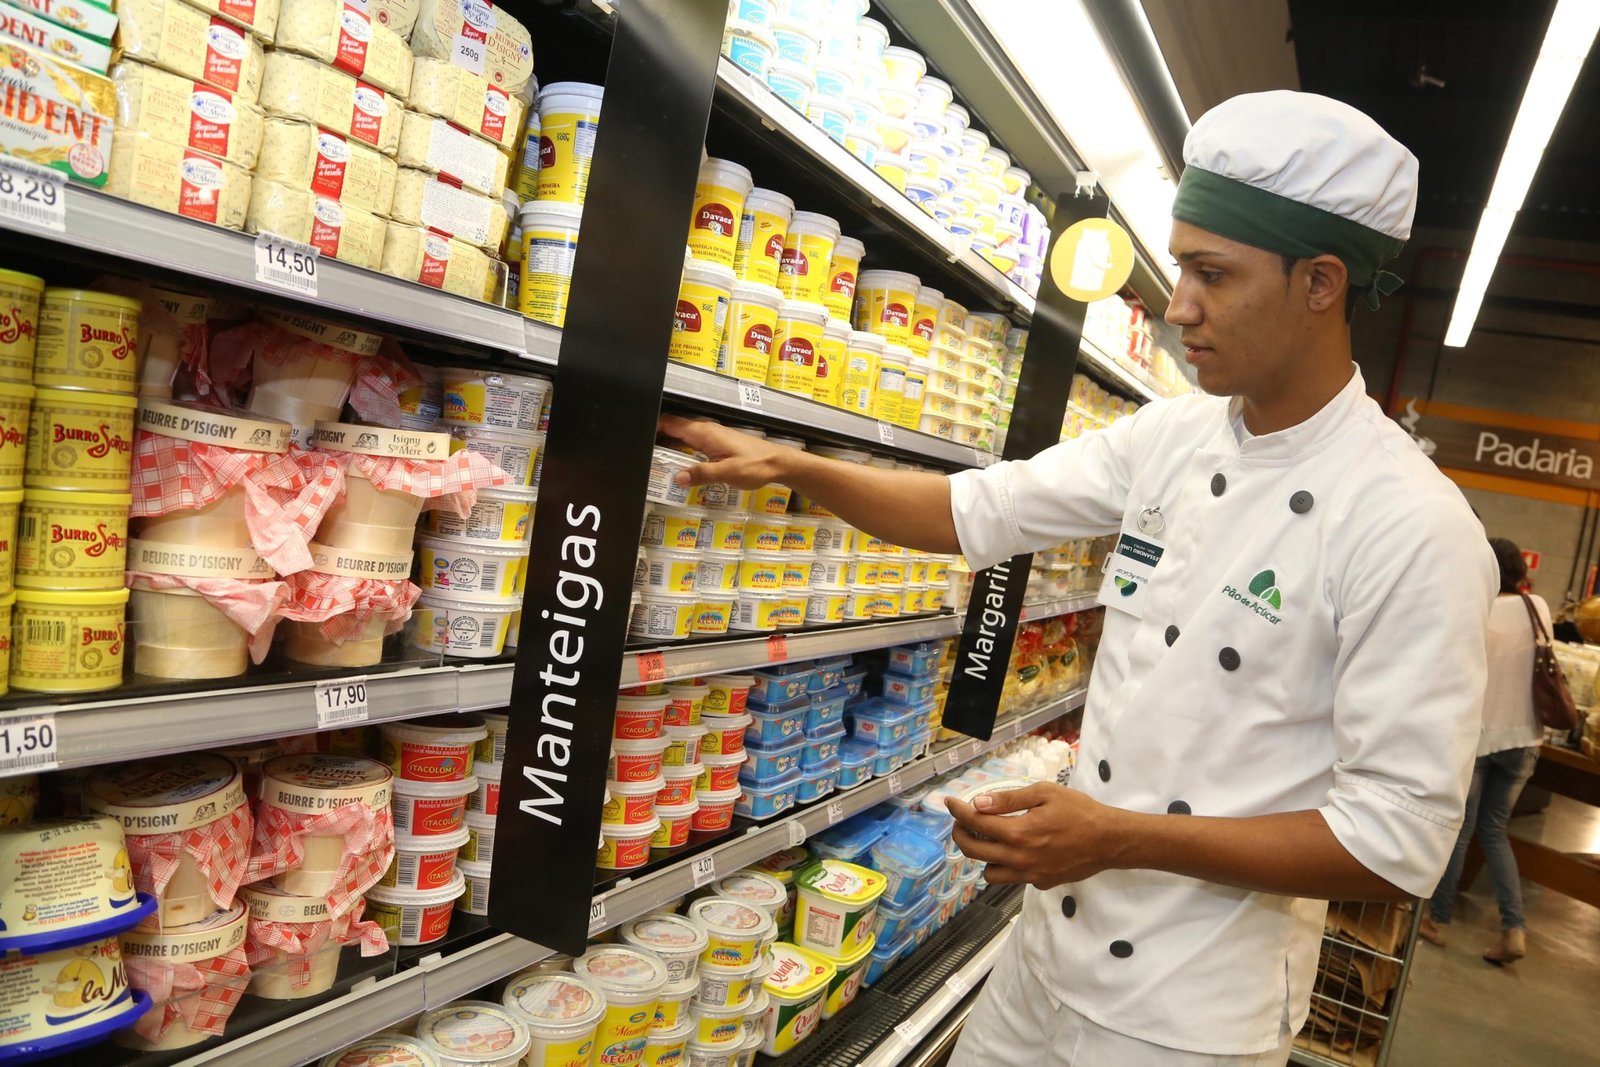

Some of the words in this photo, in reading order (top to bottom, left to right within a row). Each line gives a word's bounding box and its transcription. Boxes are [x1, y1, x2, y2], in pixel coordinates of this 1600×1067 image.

[471, 2, 490, 20] Isigny
[488, 36, 522, 64] D'ISIGNY
[495, 32, 518, 50] BEURRE
[460, 45, 479, 62] 250g
[702, 210, 733, 225] Davaca
[265, 244, 315, 276] 14,50
[80, 324, 122, 345] BURRO
[785, 344, 811, 355] Davaca
[142, 408, 178, 429] BEURRE
[180, 418, 237, 439] D'ISIGNY
[468, 415, 481, 423] 200g
[53, 423, 99, 443] BURRO
[393, 433, 421, 446] Isigny
[400, 445, 422, 456] Mère
[1475, 431, 1593, 480] Padaria
[51, 524, 97, 543] BURRO
[142, 550, 186, 567] BEURRE
[188, 555, 242, 571] D'ISIGNY
[336, 556, 376, 572] BEURRE
[378, 561, 409, 574] D'ISIGNY
[1222, 585, 1241, 602] Pão
[1240, 596, 1251, 607] de
[1250, 600, 1282, 625] Açúcar
[82, 627, 118, 645] BURRO
[519, 502, 604, 826] Manteigas
[646, 659, 661, 671] 3,89
[324, 684, 366, 708] 17,90
[279, 791, 314, 808] BEURRE
[125, 814, 178, 828] D'ISIGNY
[698, 858, 712, 872] 4,07
[124, 942, 168, 956] BEURRE
[171, 937, 222, 956] D'ISIGNY
[81, 980, 104, 1004] la
